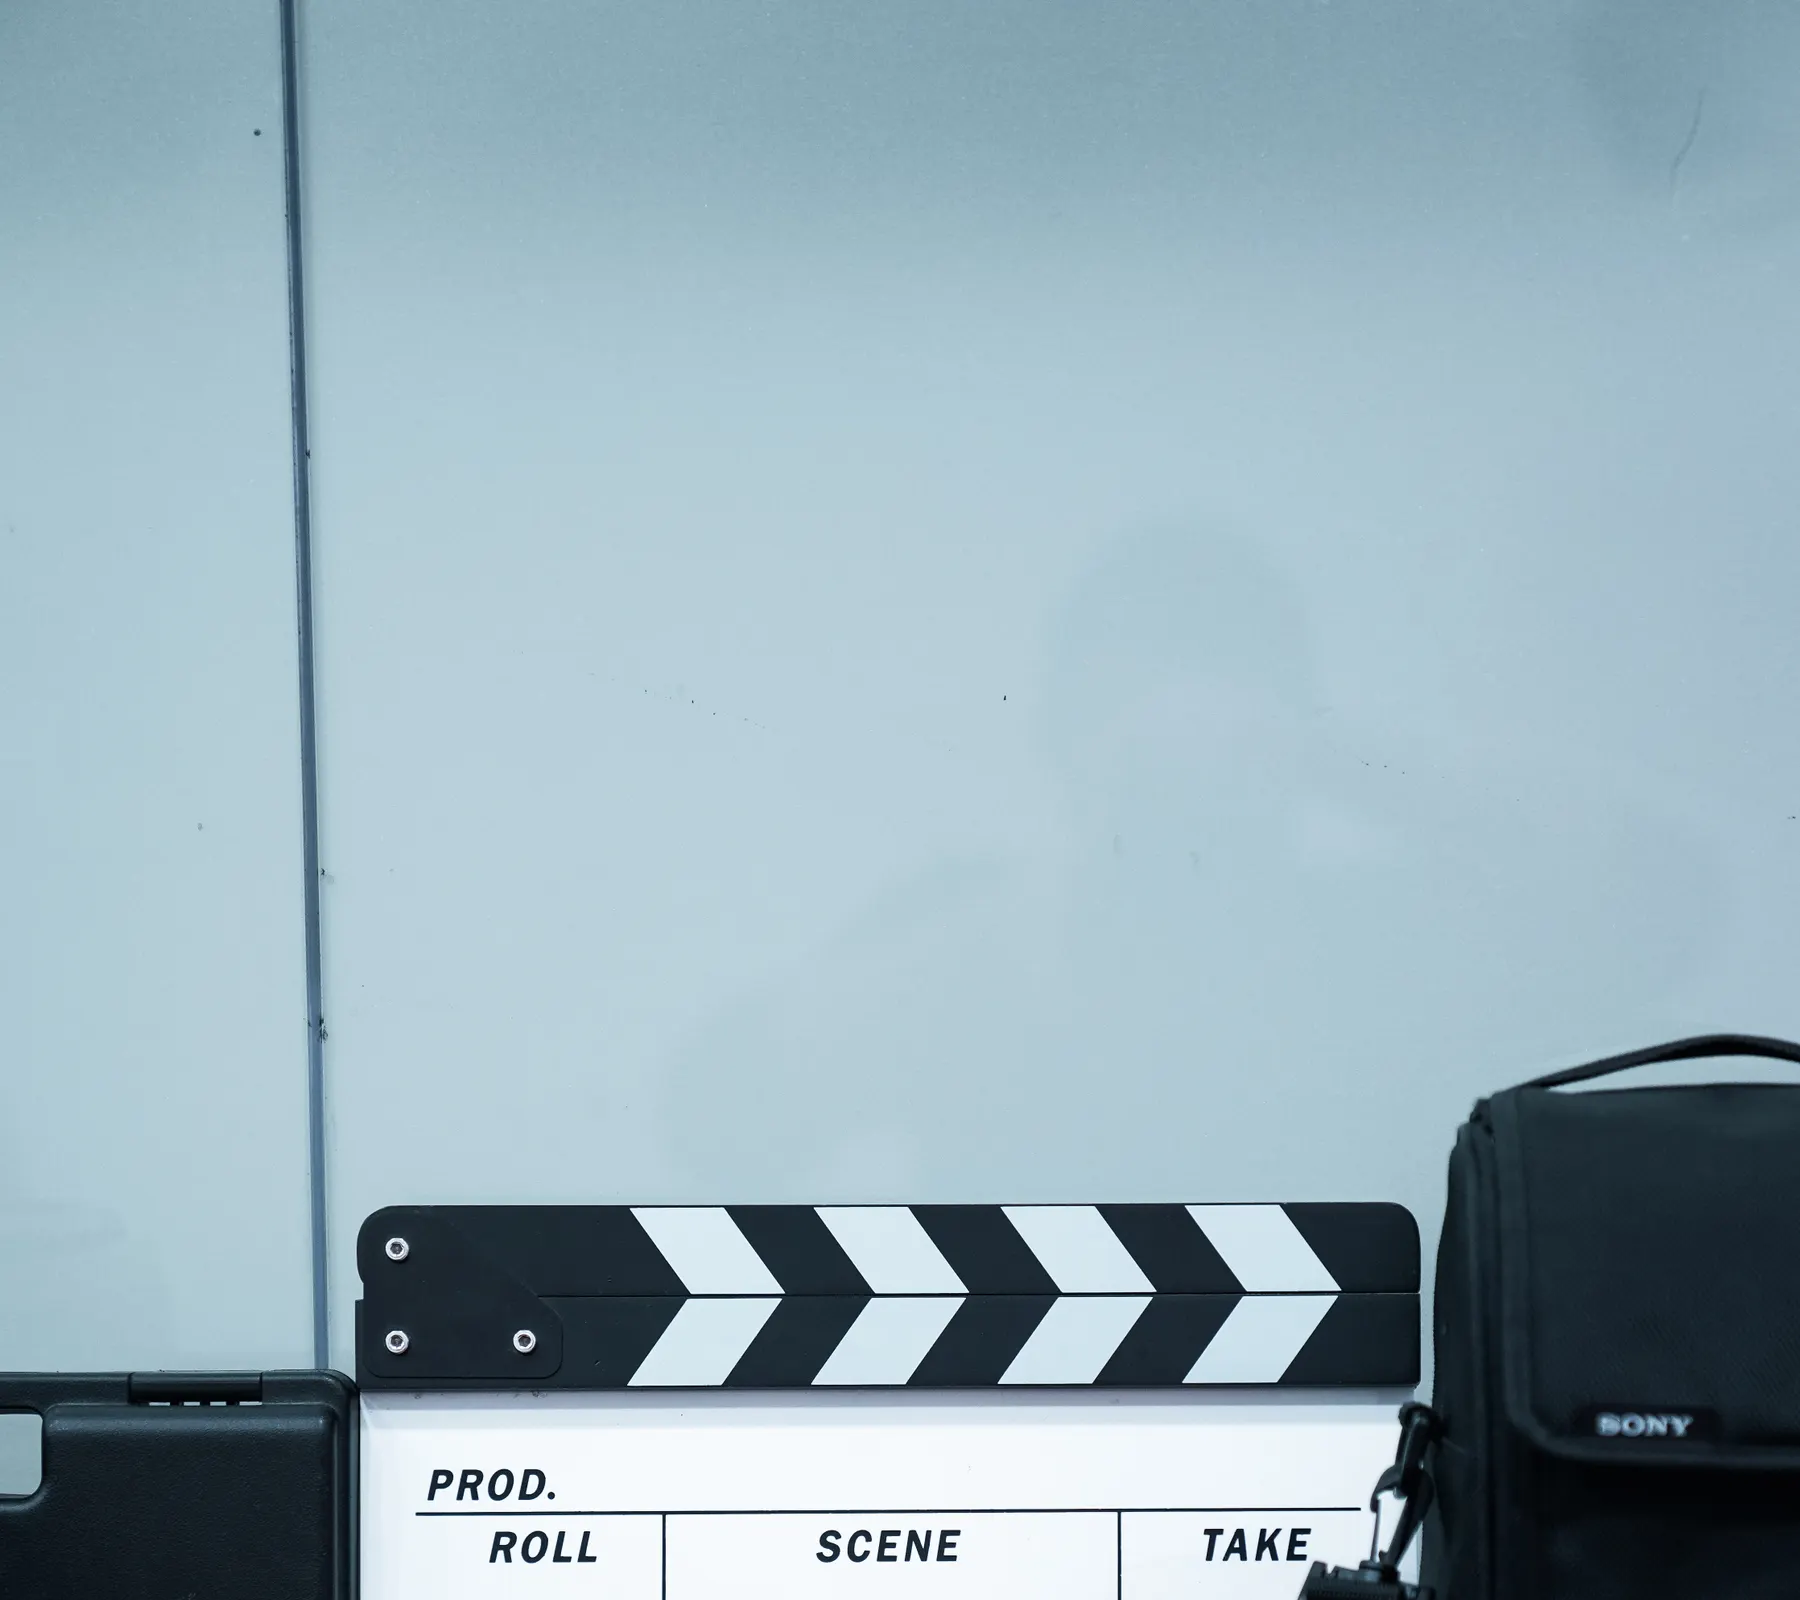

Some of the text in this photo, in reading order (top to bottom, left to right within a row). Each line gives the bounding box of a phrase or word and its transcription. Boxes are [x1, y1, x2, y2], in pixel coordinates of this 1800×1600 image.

[1597, 1412, 1693, 1437] SONY
[427, 1468, 556, 1502] PROD.
[488, 1530, 598, 1564] ROLL
[815, 1529, 962, 1564] SCENE
[1202, 1527, 1312, 1562] TAKE
